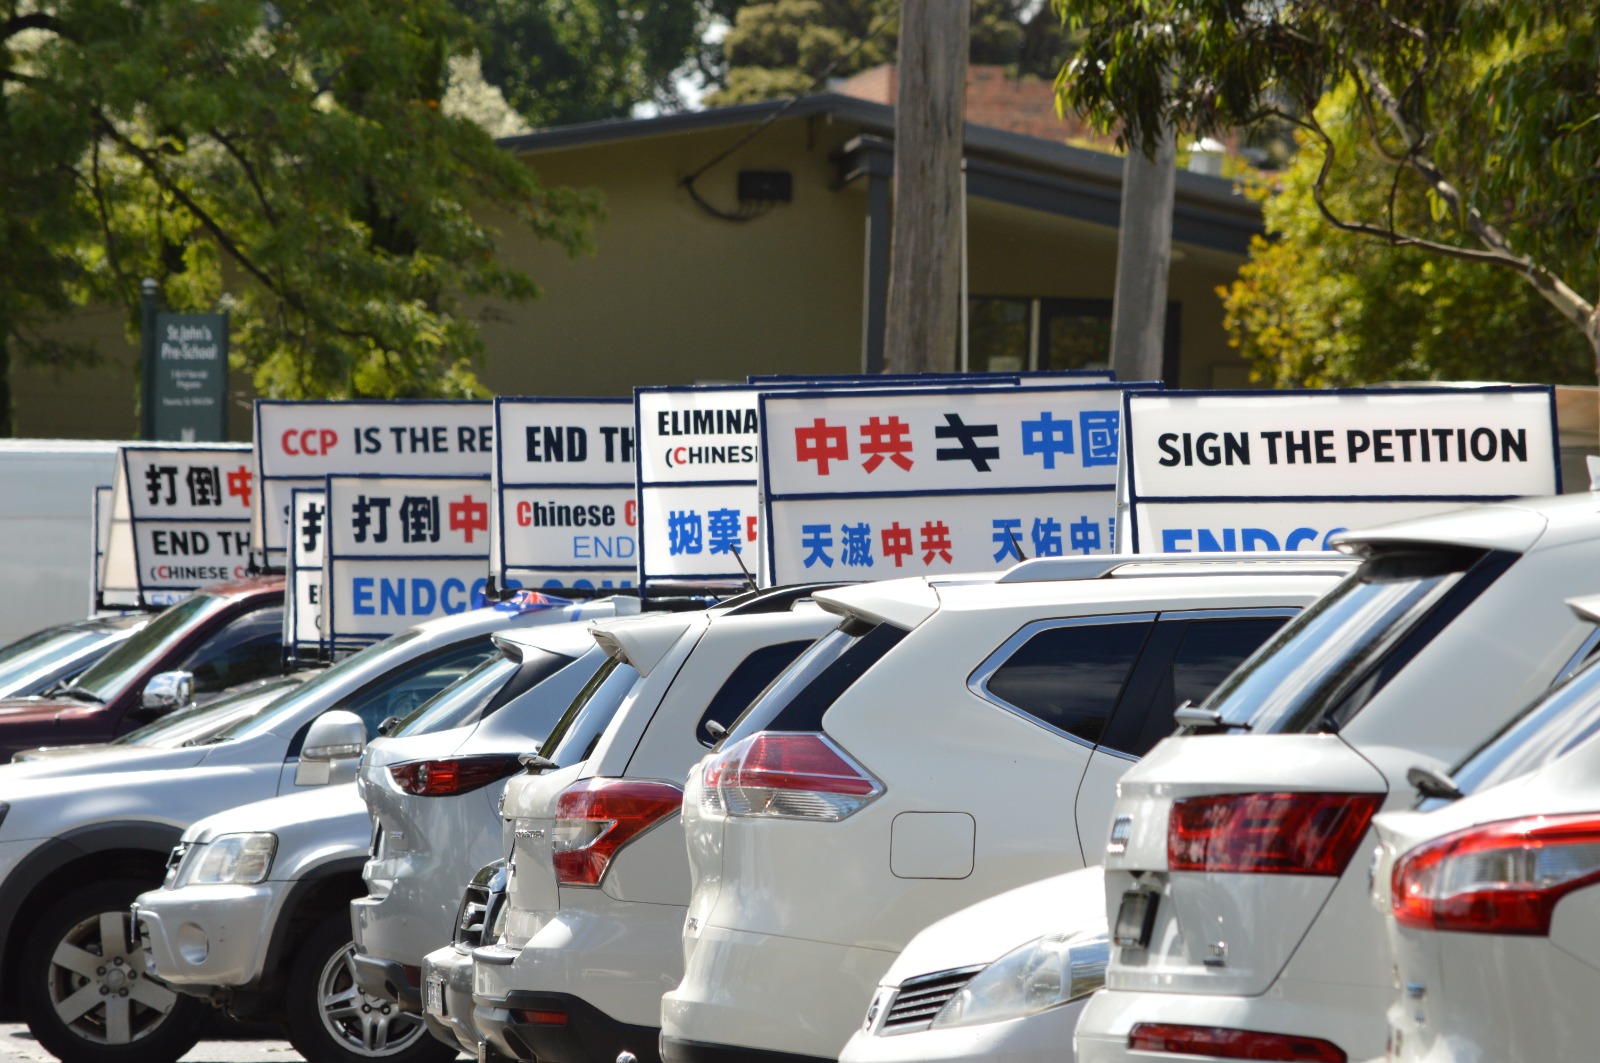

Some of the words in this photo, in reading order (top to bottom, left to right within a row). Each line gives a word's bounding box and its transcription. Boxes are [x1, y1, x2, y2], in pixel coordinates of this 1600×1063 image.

[658, 408, 757, 436] ELIMINA
[282, 429, 338, 456] CCP
[355, 427, 382, 454] IS
[389, 427, 449, 453] THE
[526, 426, 587, 462] END
[1157, 431, 1251, 468] SIGN
[1260, 430, 1337, 465] THE
[1346, 427, 1528, 464] PETITION
[665, 445, 758, 469] (CHINES
[352, 495, 489, 543] 打倒中
[516, 500, 616, 527] Chinese
[152, 530, 209, 555] END
[573, 536, 635, 559] END
[992, 515, 1116, 564] 天佑中
[151, 566, 229, 581] (CHINESE
